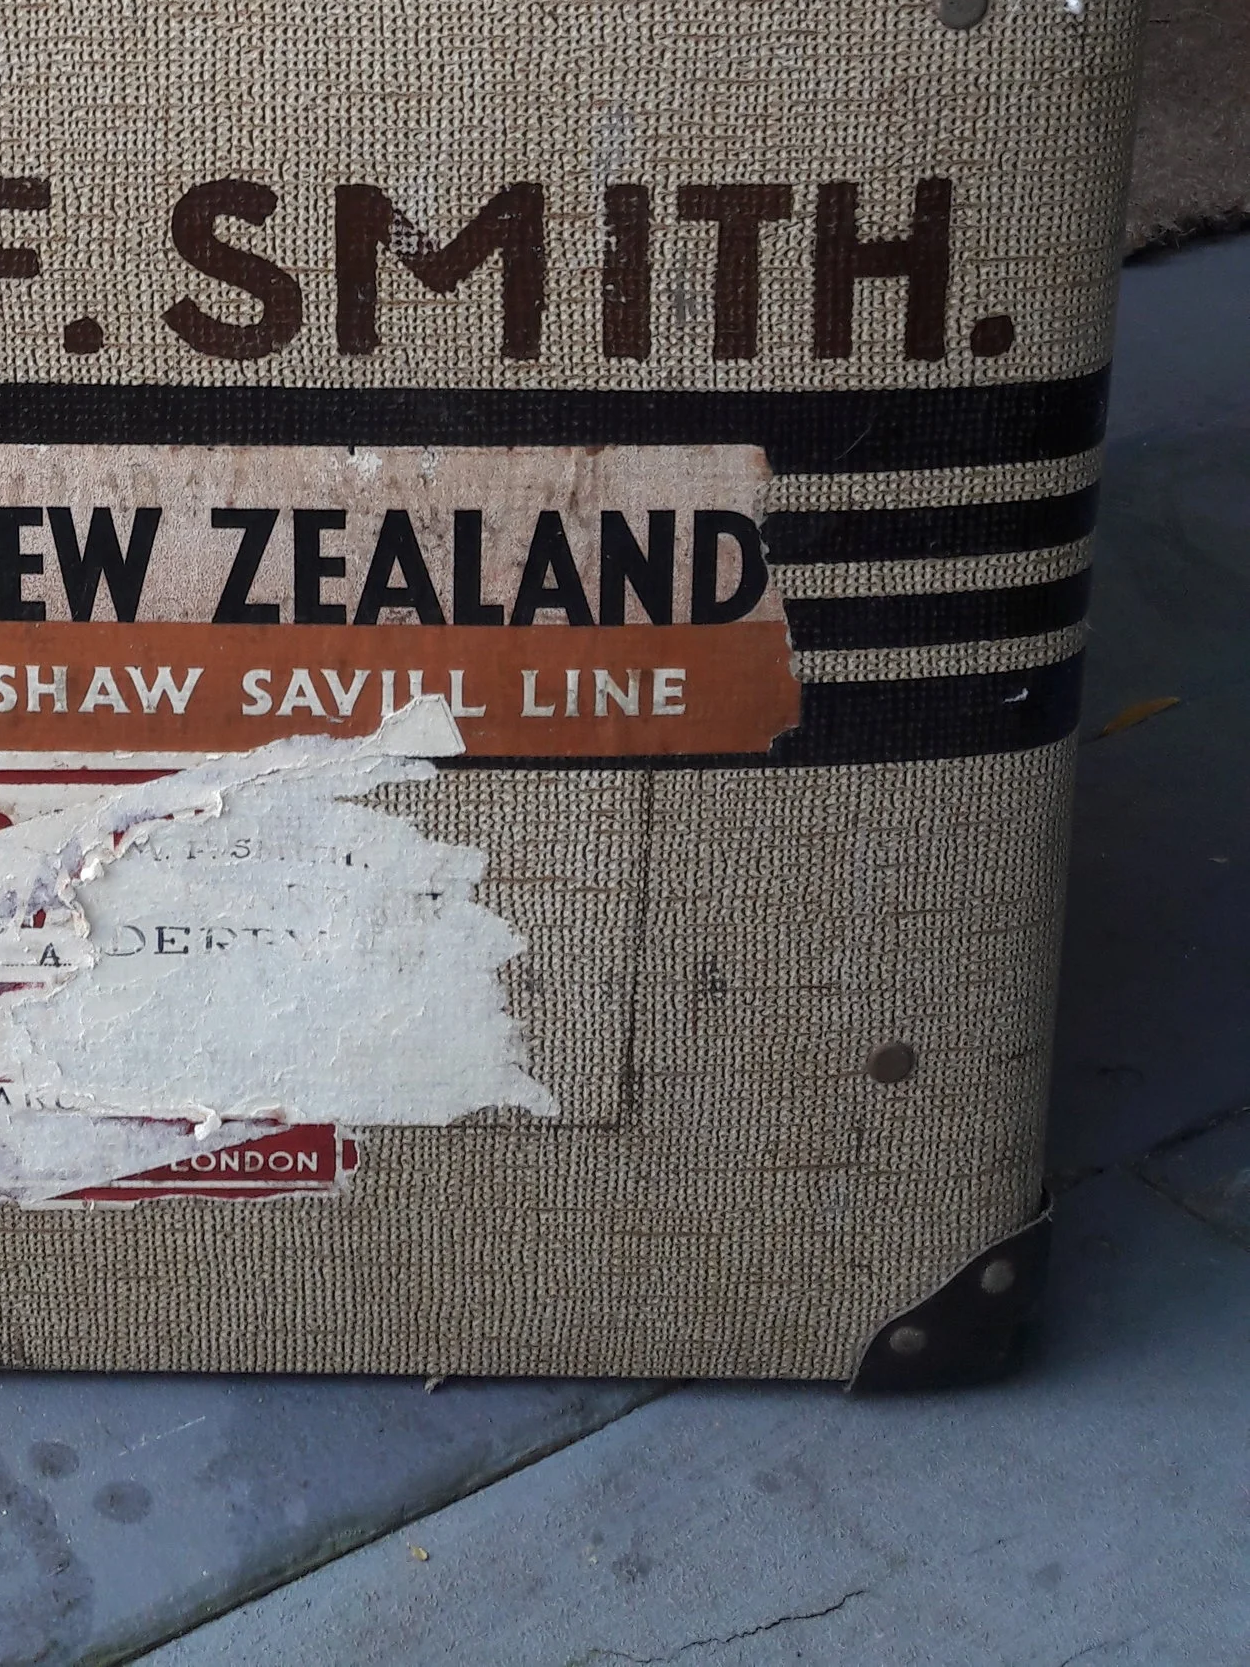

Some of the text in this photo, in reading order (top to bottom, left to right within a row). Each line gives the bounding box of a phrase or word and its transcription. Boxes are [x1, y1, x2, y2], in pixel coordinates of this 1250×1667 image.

[210, 507, 770, 627] ZEALAND
[519, 668, 688, 718] LINE
[169, 1149, 319, 1173] LONDON
